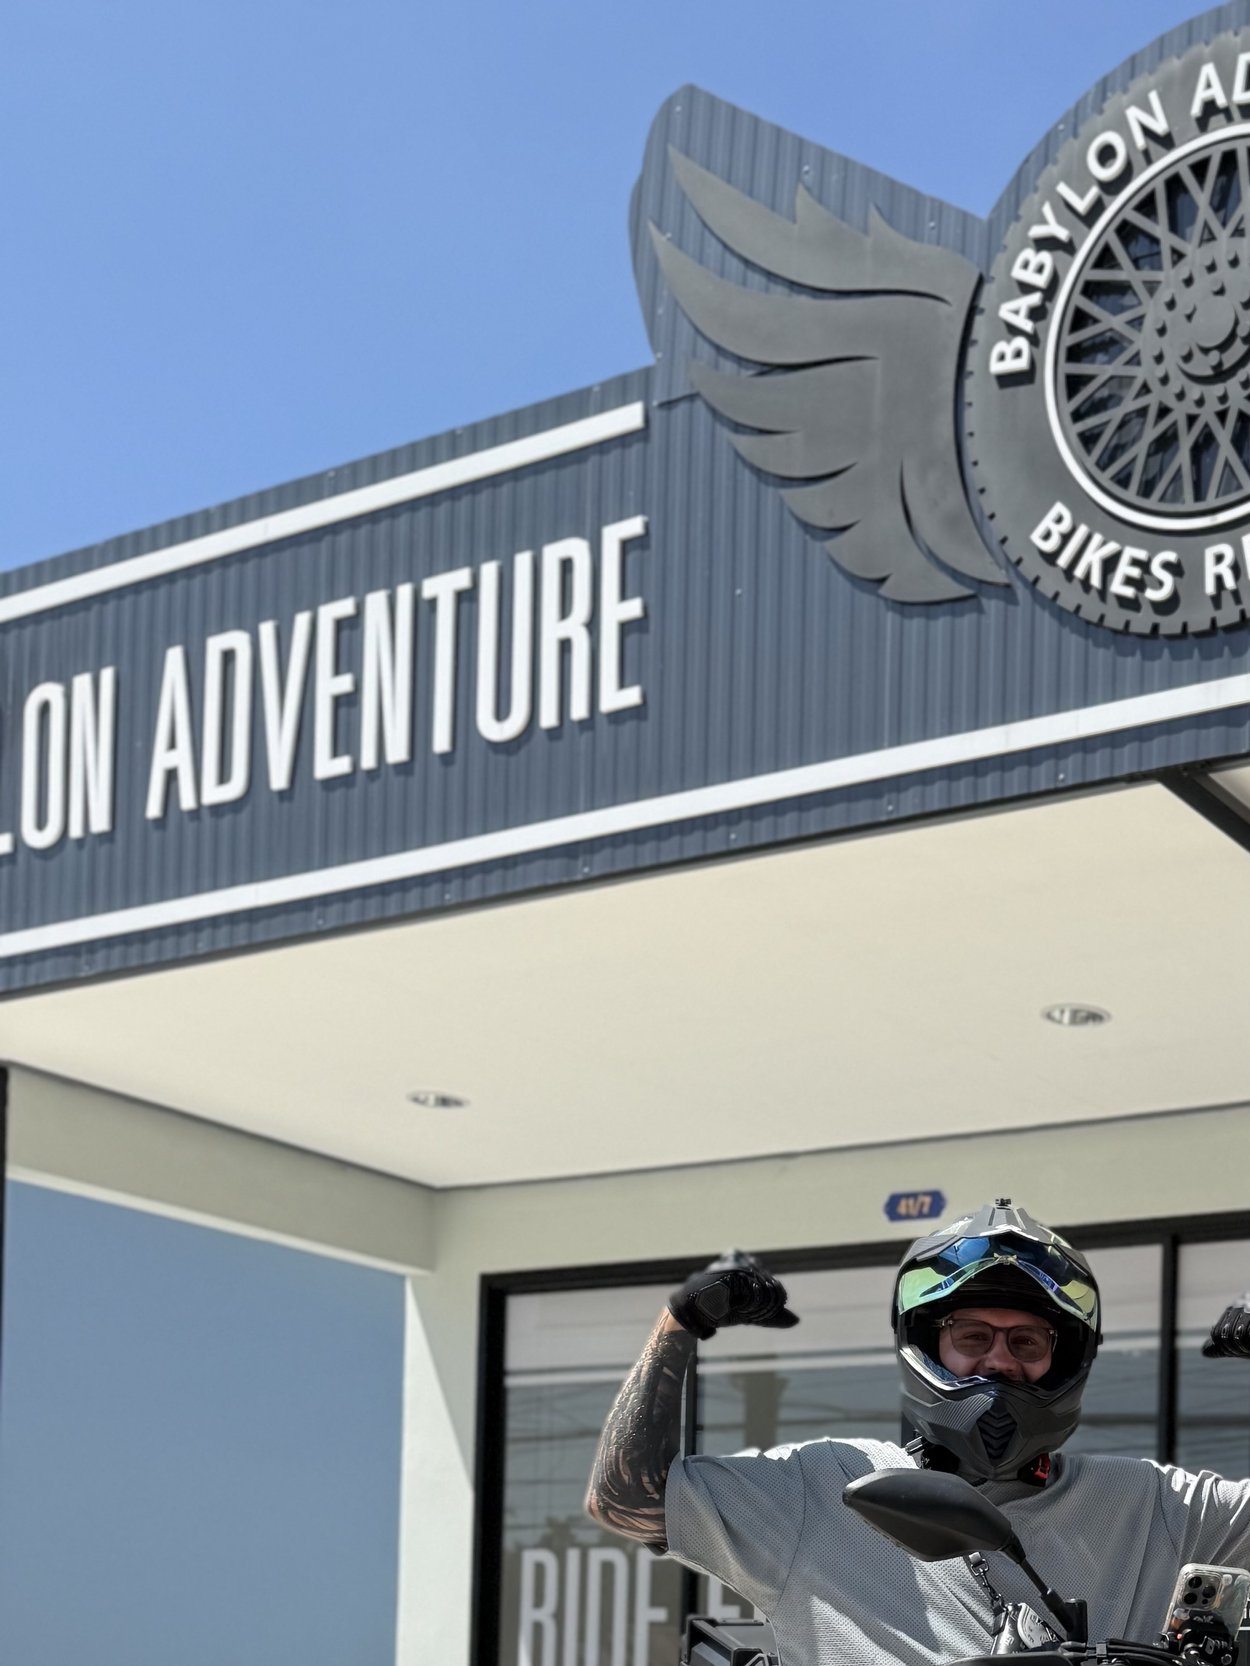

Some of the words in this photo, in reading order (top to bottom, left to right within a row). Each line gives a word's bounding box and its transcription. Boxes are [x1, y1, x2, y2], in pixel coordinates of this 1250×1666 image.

[990, 90, 1170, 378] BABYLON
[0, 667, 117, 855] ON
[145, 515, 649, 820] ADVENTURE
[1030, 502, 1181, 602] BIKES
